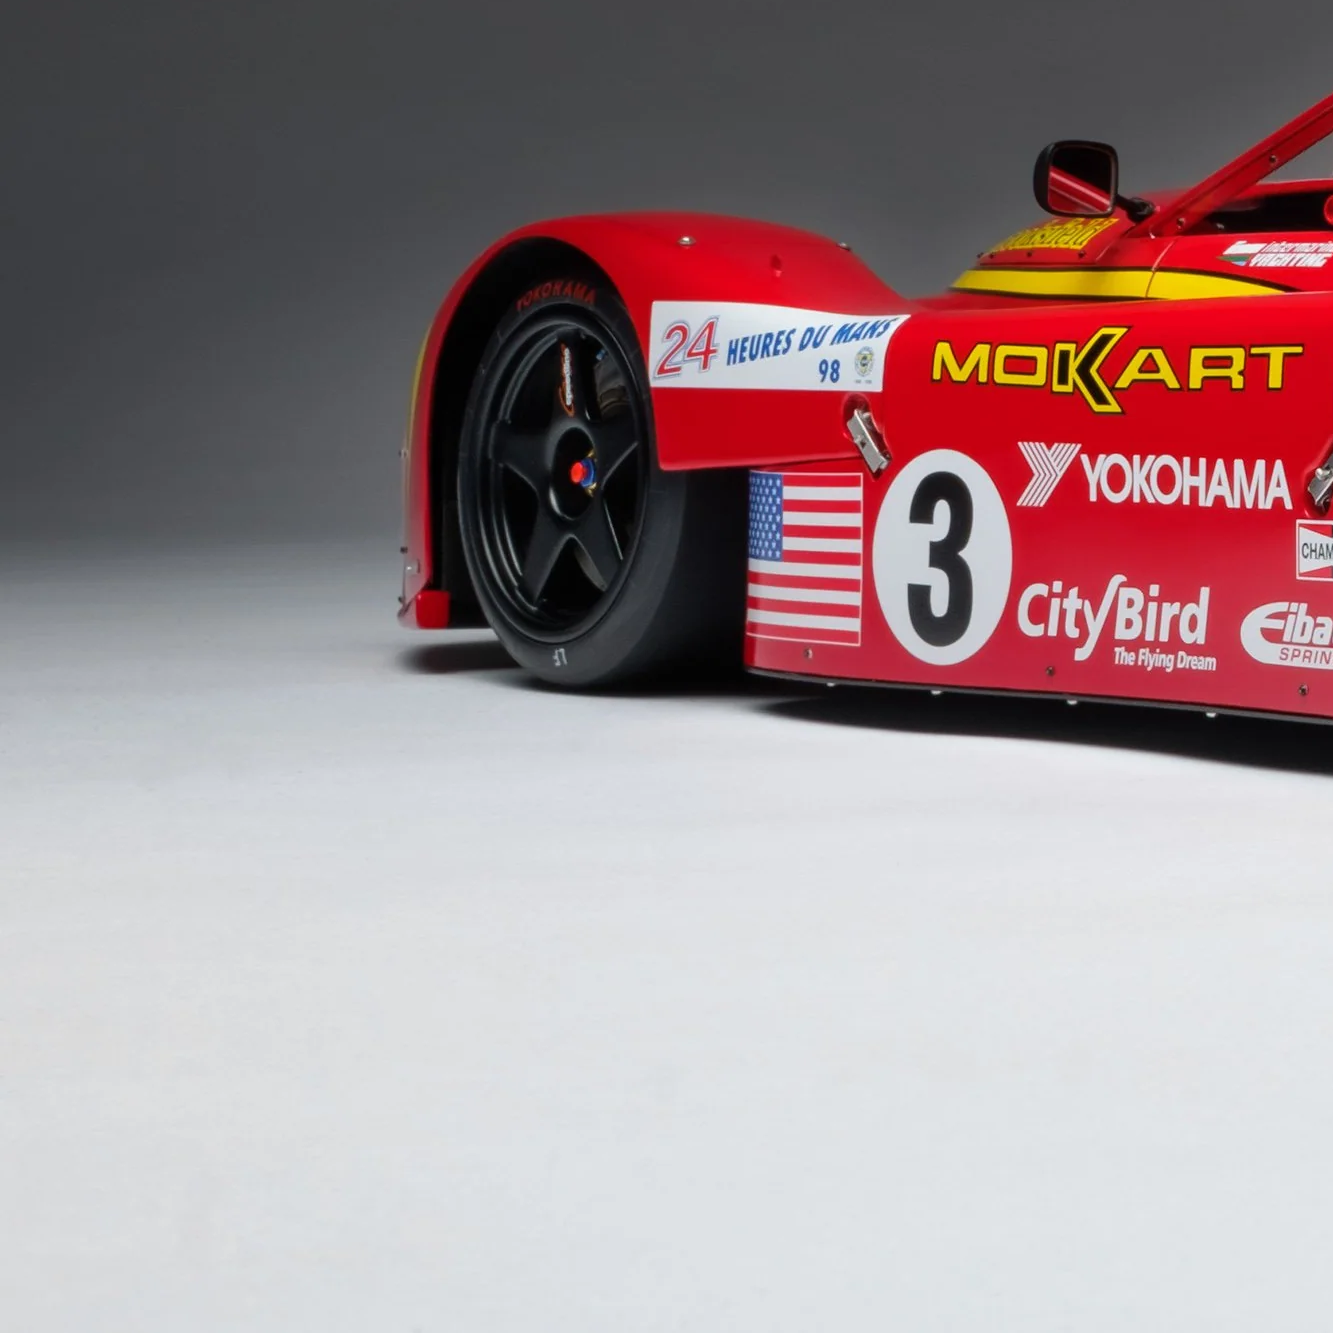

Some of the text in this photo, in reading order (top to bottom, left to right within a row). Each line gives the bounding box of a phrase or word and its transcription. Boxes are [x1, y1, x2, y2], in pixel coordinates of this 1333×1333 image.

[516, 281, 597, 311] YOKOHAMA
[655, 317, 899, 379] 24 HEURES DU MANS
[818, 359, 841, 383] 98
[932, 326, 1303, 414] MOKART
[1080, 454, 1293, 510] YOKOHAMA
[907, 471, 973, 647] 3
[1114, 647, 1216, 672] The Flying Dream
